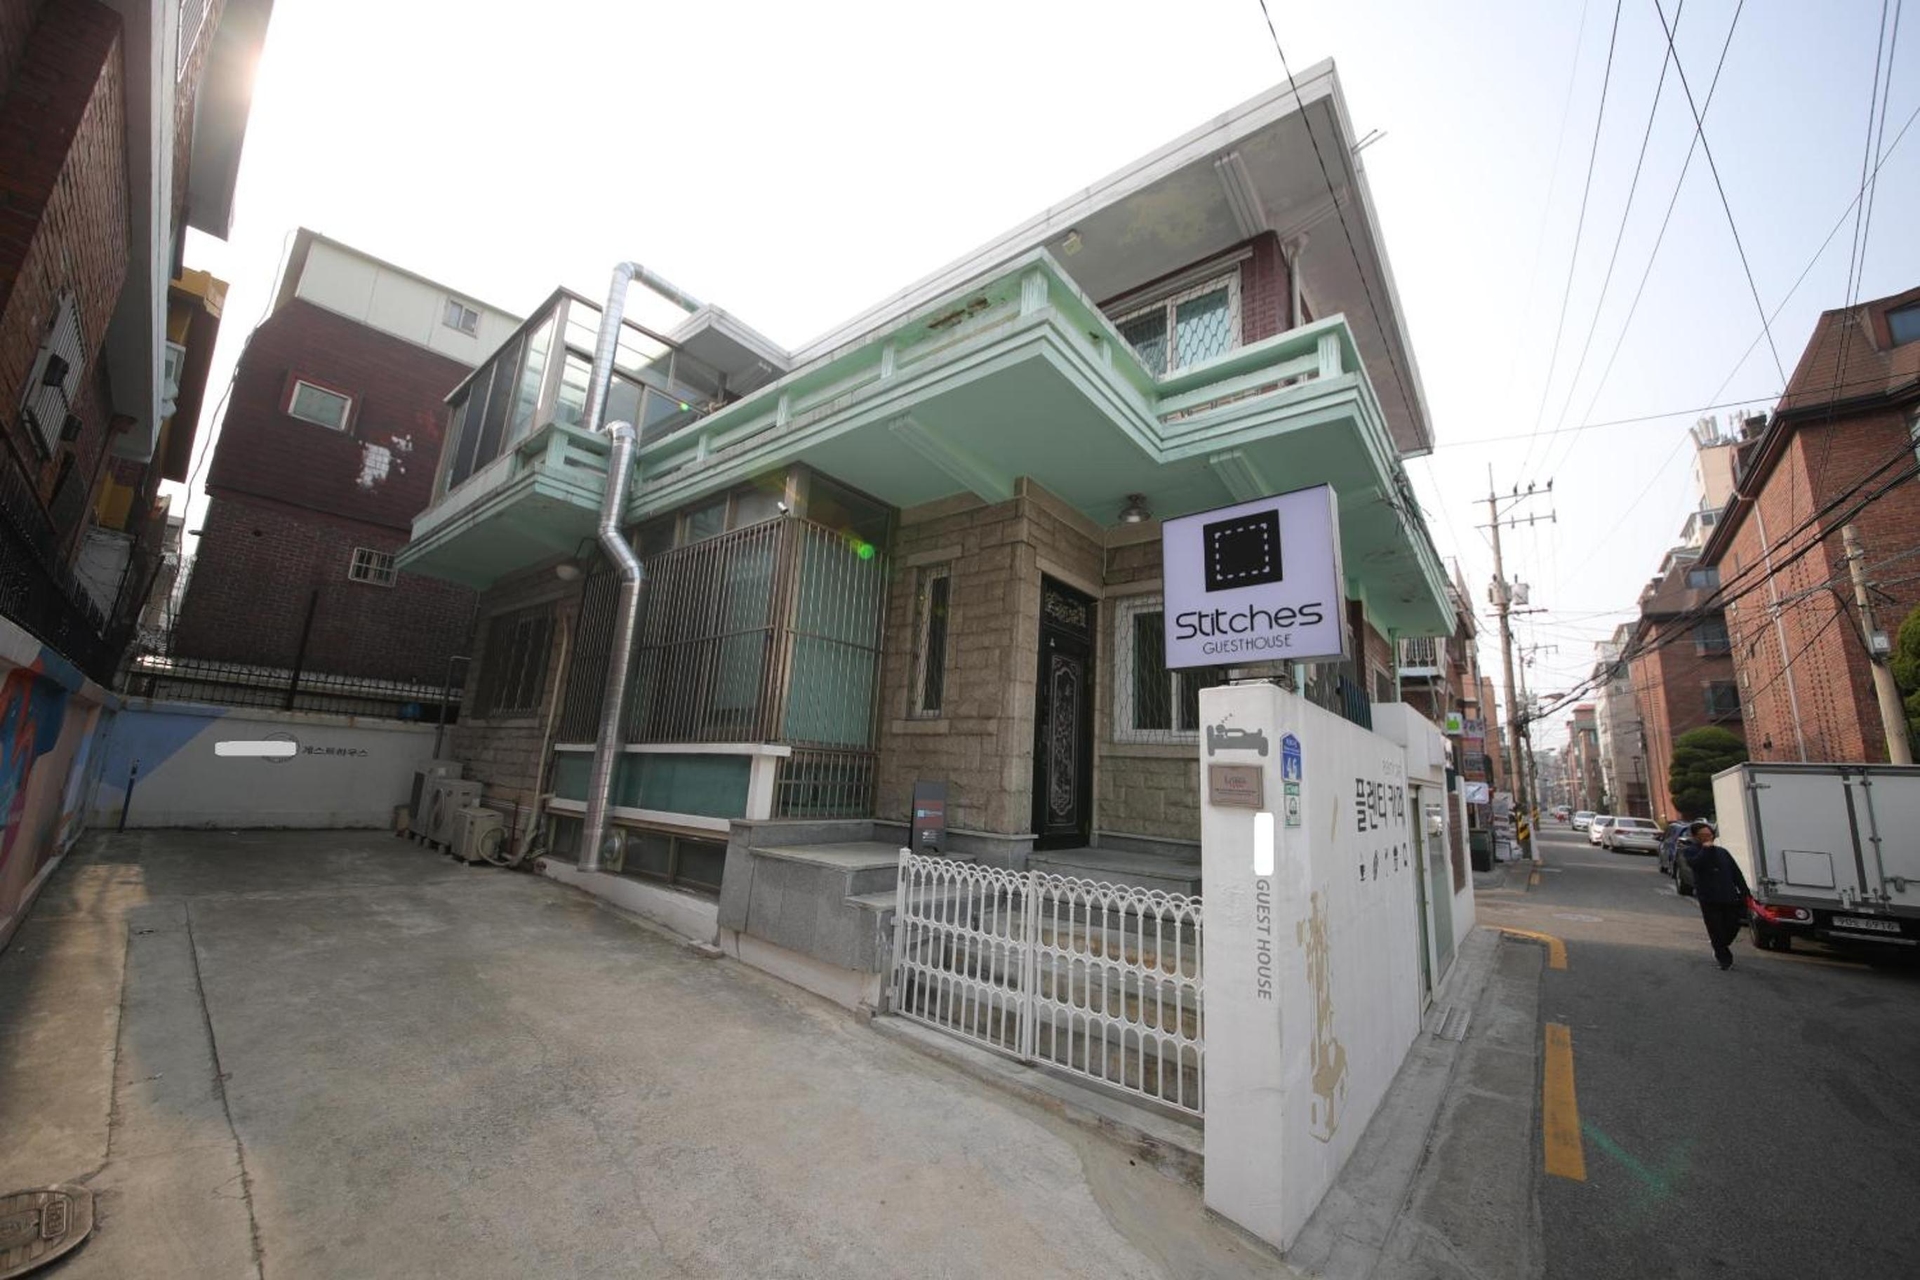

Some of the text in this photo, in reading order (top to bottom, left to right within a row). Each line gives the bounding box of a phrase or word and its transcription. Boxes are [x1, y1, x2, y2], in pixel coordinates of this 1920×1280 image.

[1176, 602, 1323, 640] Stitches
[1202, 634, 1293, 656] GUESTHOUSE
[1256, 879, 1272, 1000] GUEST HOUSE
